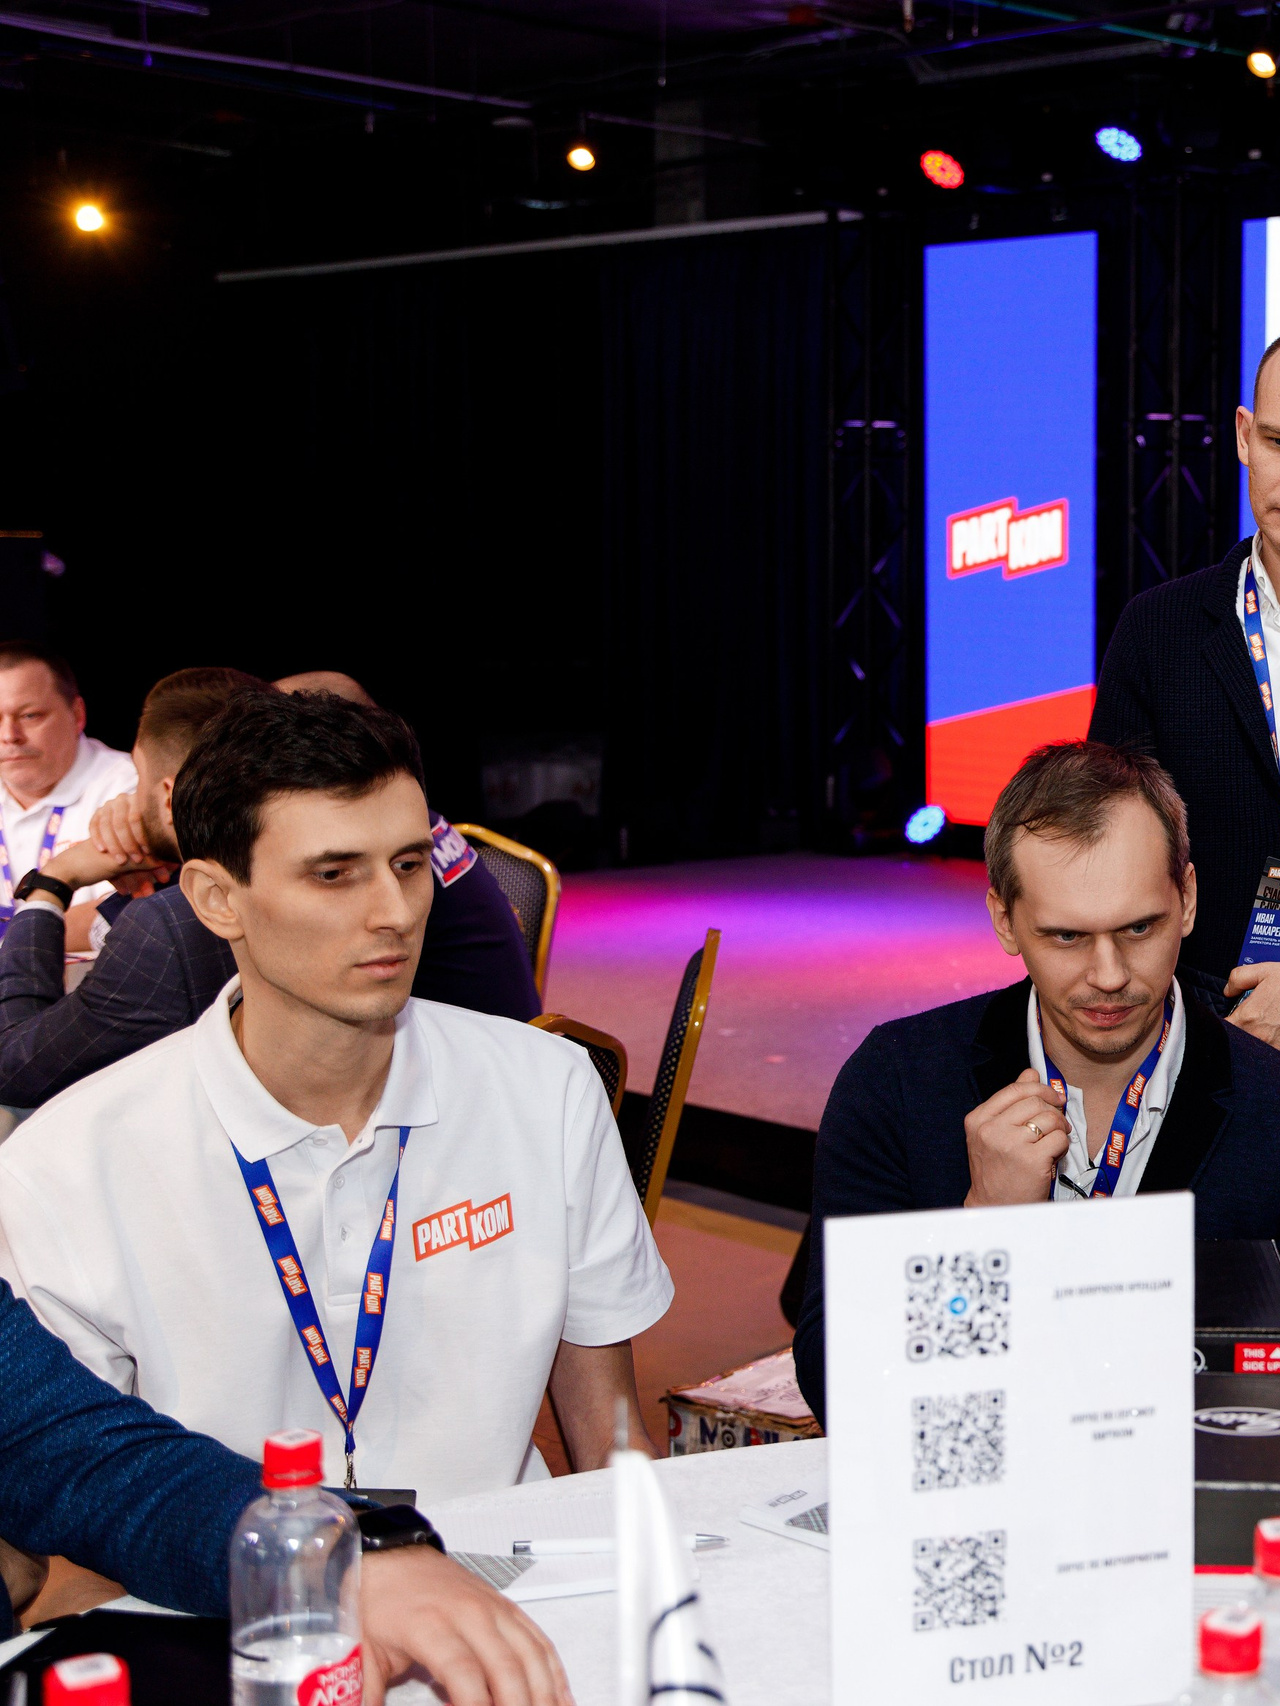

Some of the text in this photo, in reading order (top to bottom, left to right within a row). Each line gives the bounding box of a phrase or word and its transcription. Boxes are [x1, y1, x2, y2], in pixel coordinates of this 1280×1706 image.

[1255, 912, 1275, 924] ИВАН
[1242, 1348, 1266, 1358] THIS
[1242, 1361, 1265, 1371] SIDE
